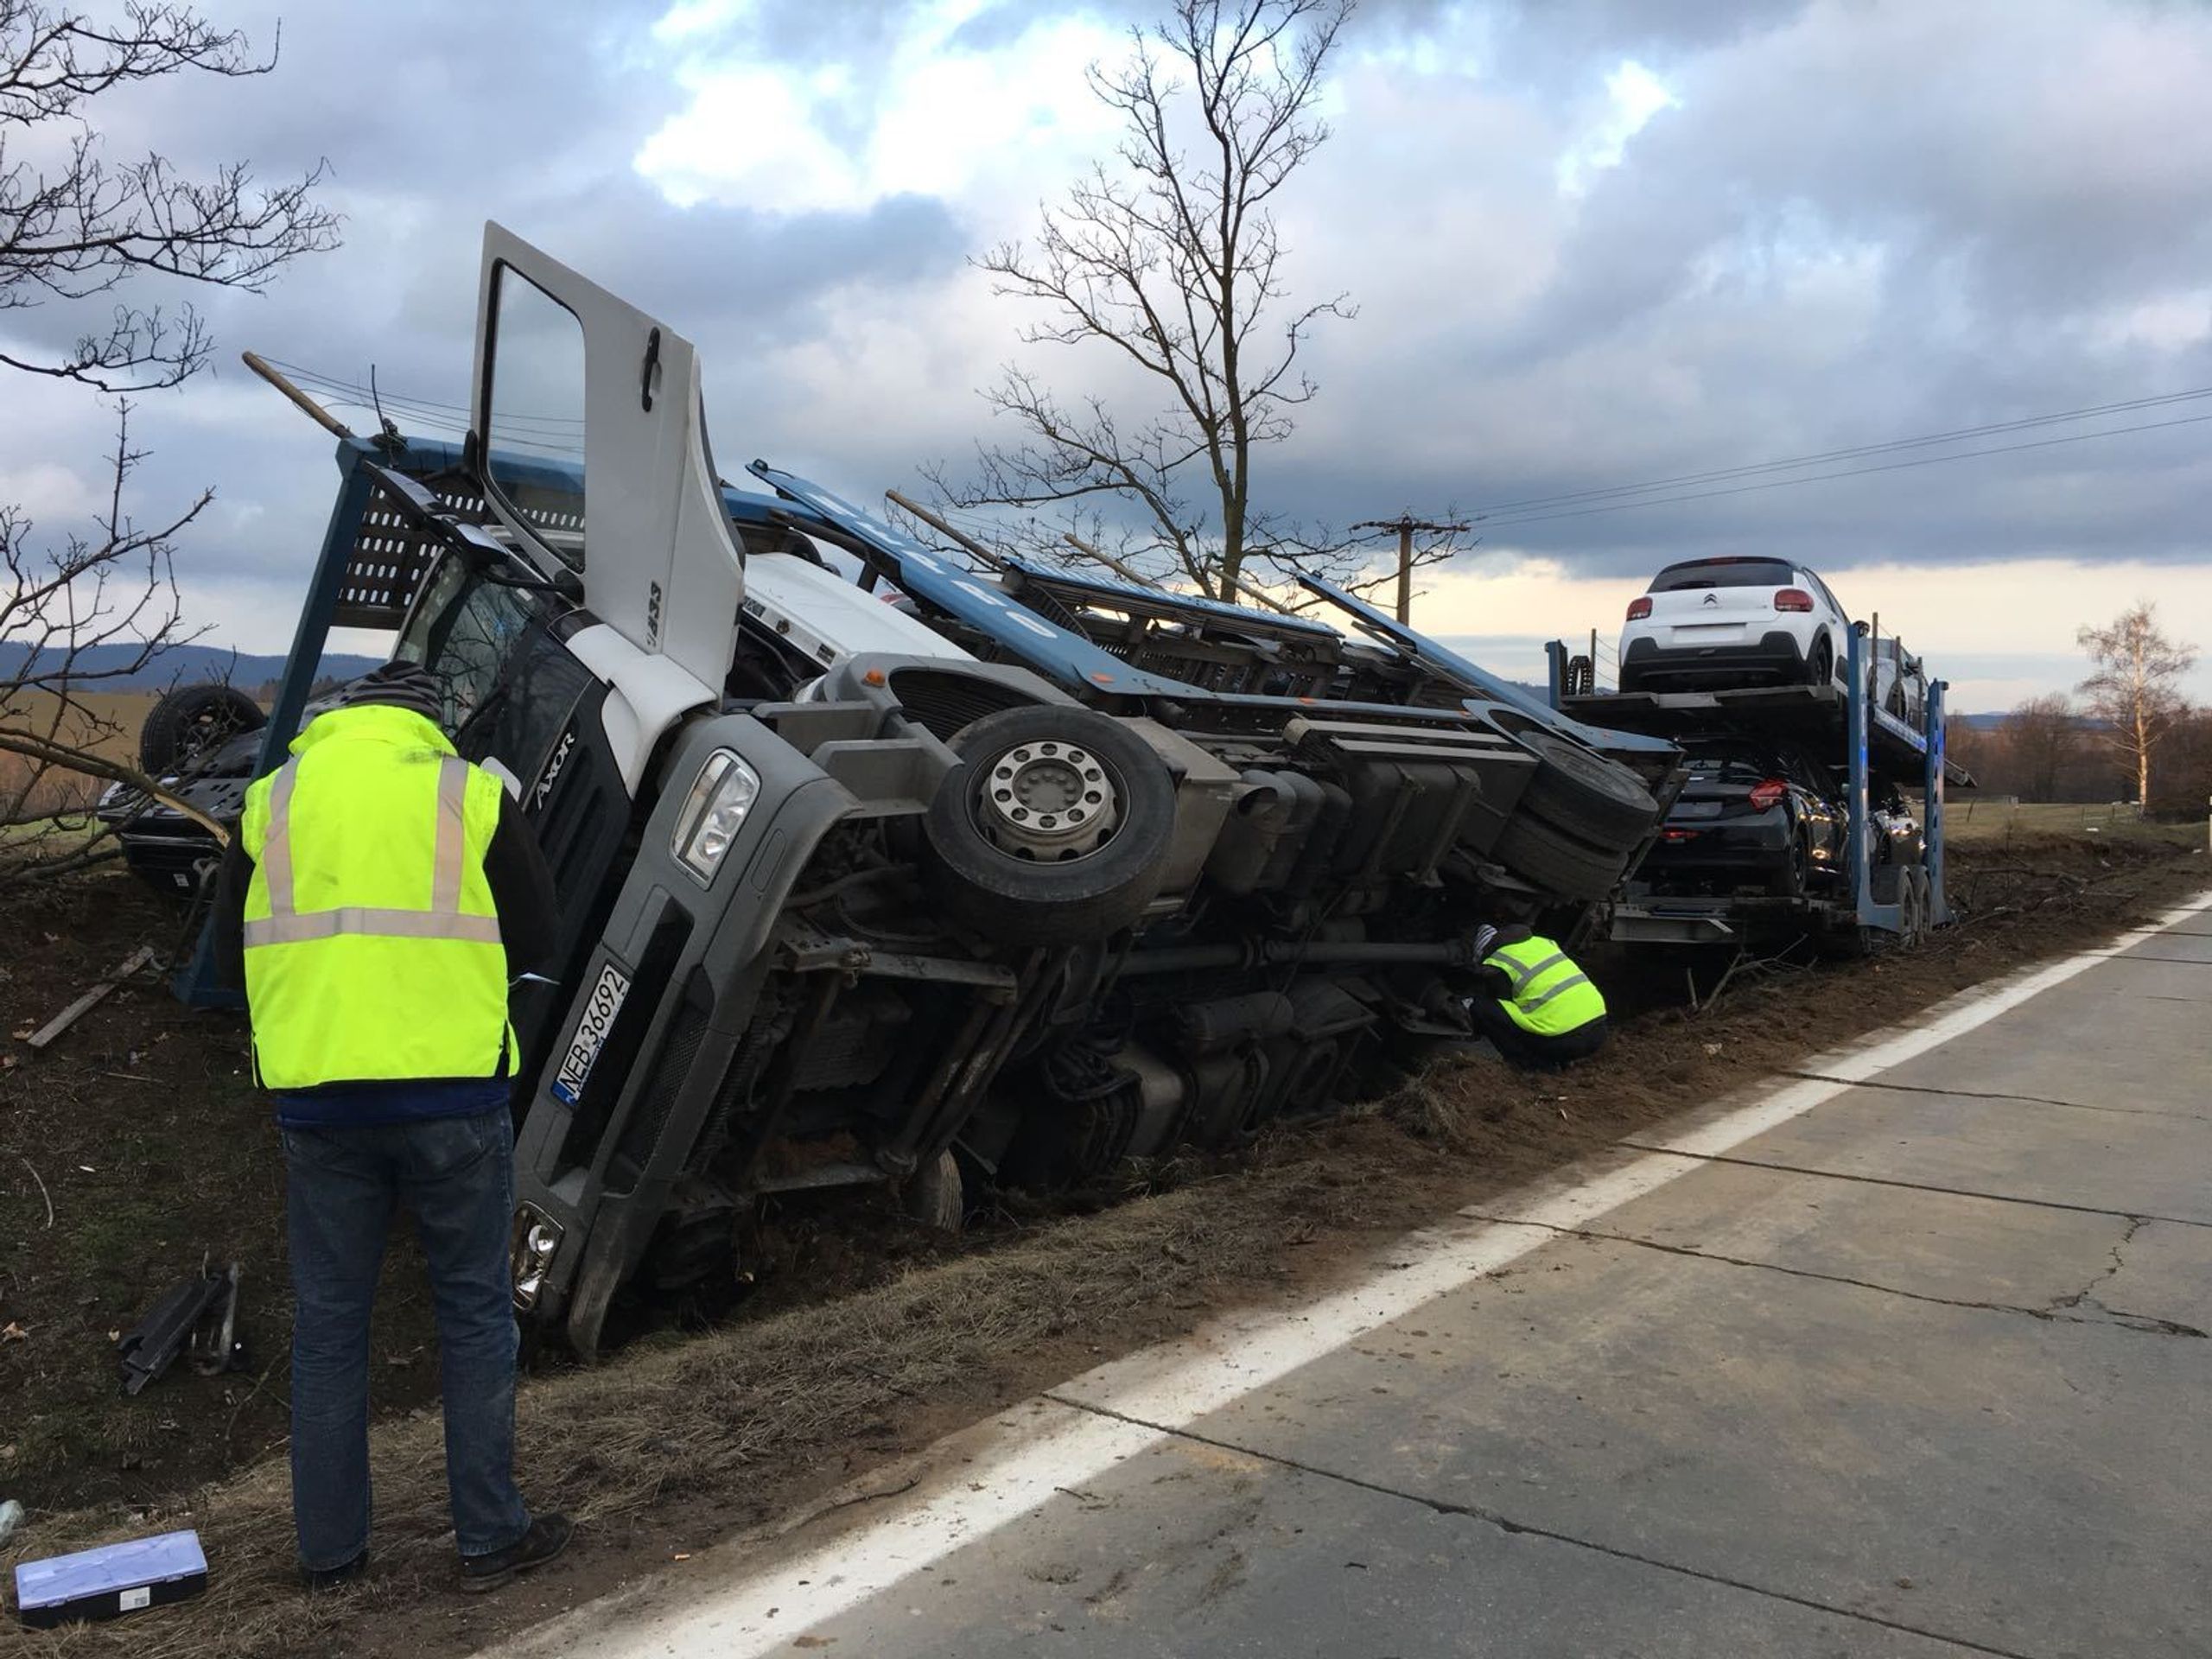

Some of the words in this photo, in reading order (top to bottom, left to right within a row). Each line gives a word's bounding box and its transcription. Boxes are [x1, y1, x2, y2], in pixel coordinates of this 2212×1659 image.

[537, 733, 575, 810] AXOR
[559, 1044, 591, 1094] NEB
[581, 969, 625, 1046] 36692
